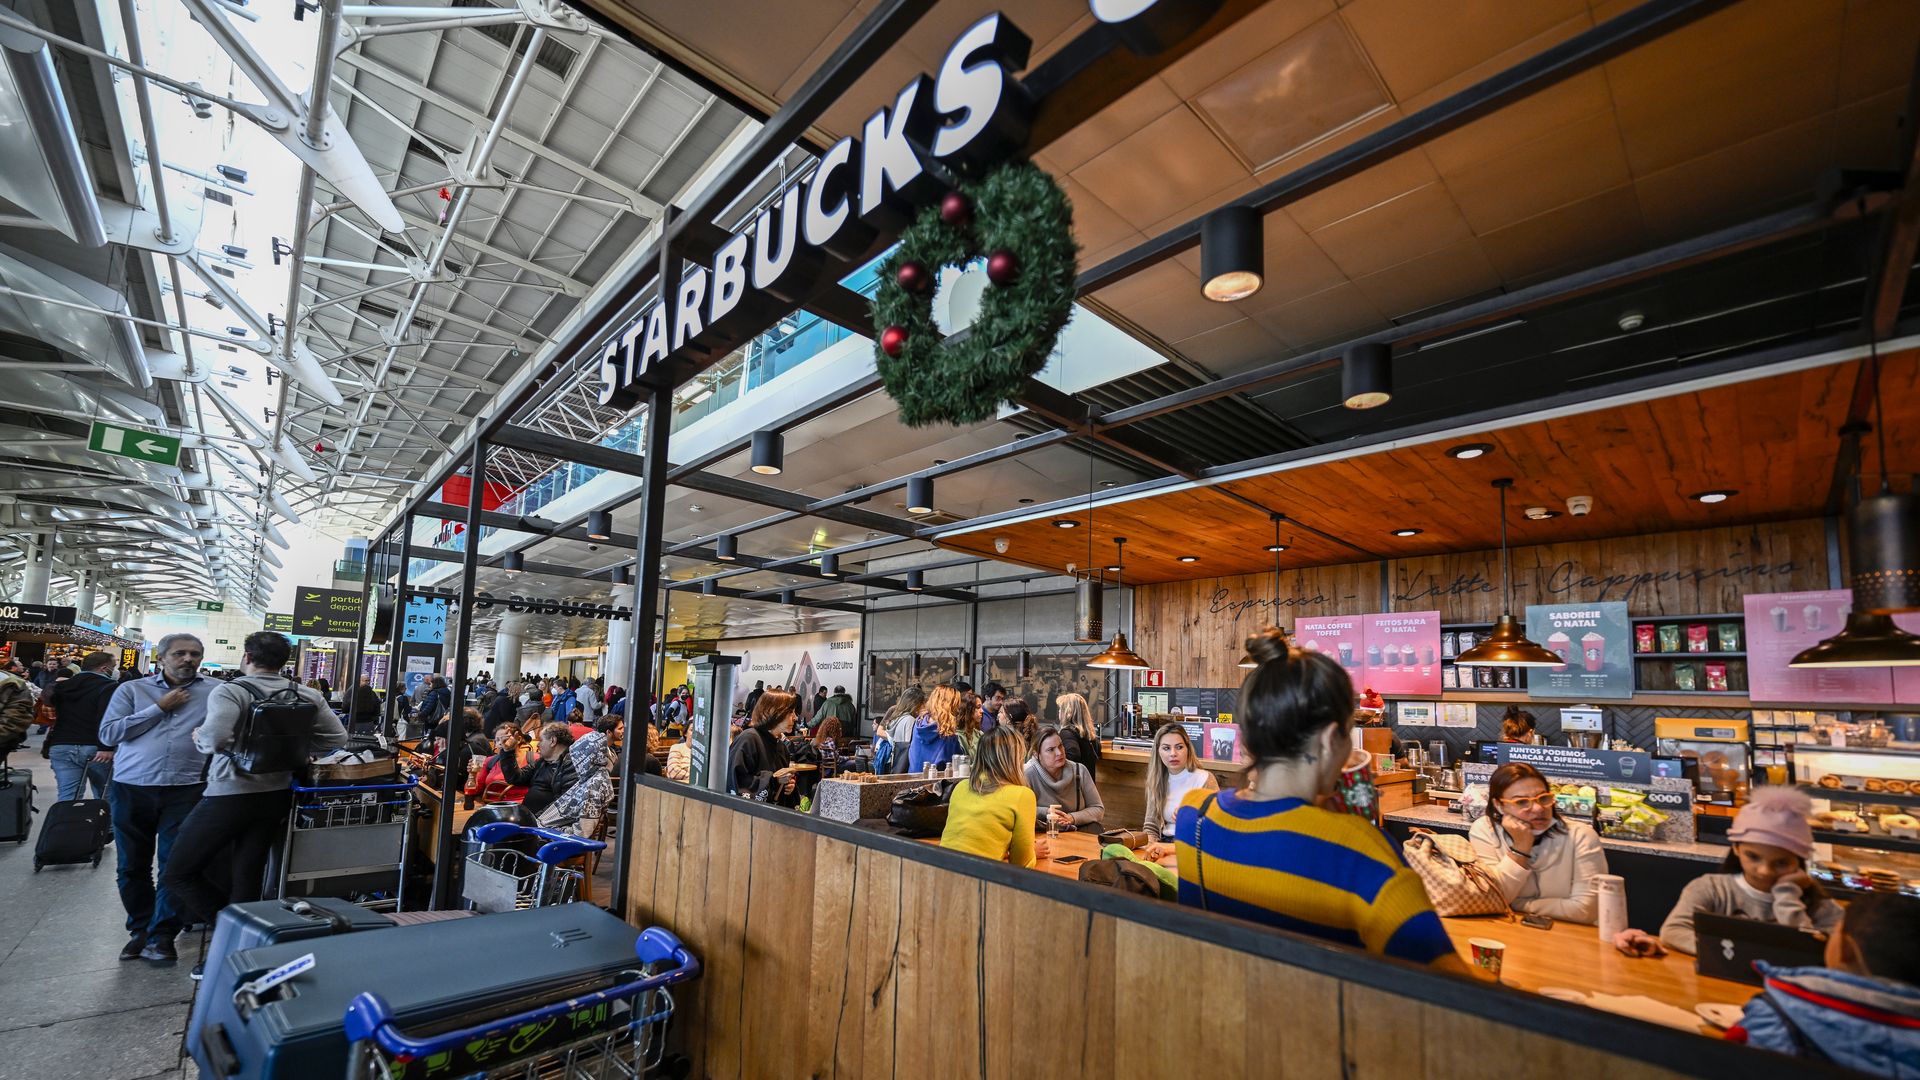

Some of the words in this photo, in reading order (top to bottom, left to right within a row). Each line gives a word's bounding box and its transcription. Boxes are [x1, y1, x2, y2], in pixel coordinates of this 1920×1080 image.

[597, 11, 1004, 405] STARBUCKS
[1210, 588, 1330, 621] Espresso
[1395, 569, 1498, 600] Latte
[1549, 611, 1601, 620] SABOREIE
[1375, 619, 1402, 627] FEITOS
[1403, 618, 1426, 626] PARA
[1553, 620, 1562, 628] O
[1563, 619, 1598, 627] NATAL
[830, 641, 854, 650] SAMSUNG
[752, 664, 765, 672] Galaxy
[816, 662, 833, 672] Galaxy
[833, 661, 841, 670] S22
[841, 661, 853, 669] Ultra
[1508, 746, 1542, 755] JUNTOS
[1542, 749, 1587, 758] PODEMOS
[1508, 753, 1545, 762] MARCAR
[1553, 756, 1605, 766] DIFERENÇA.
